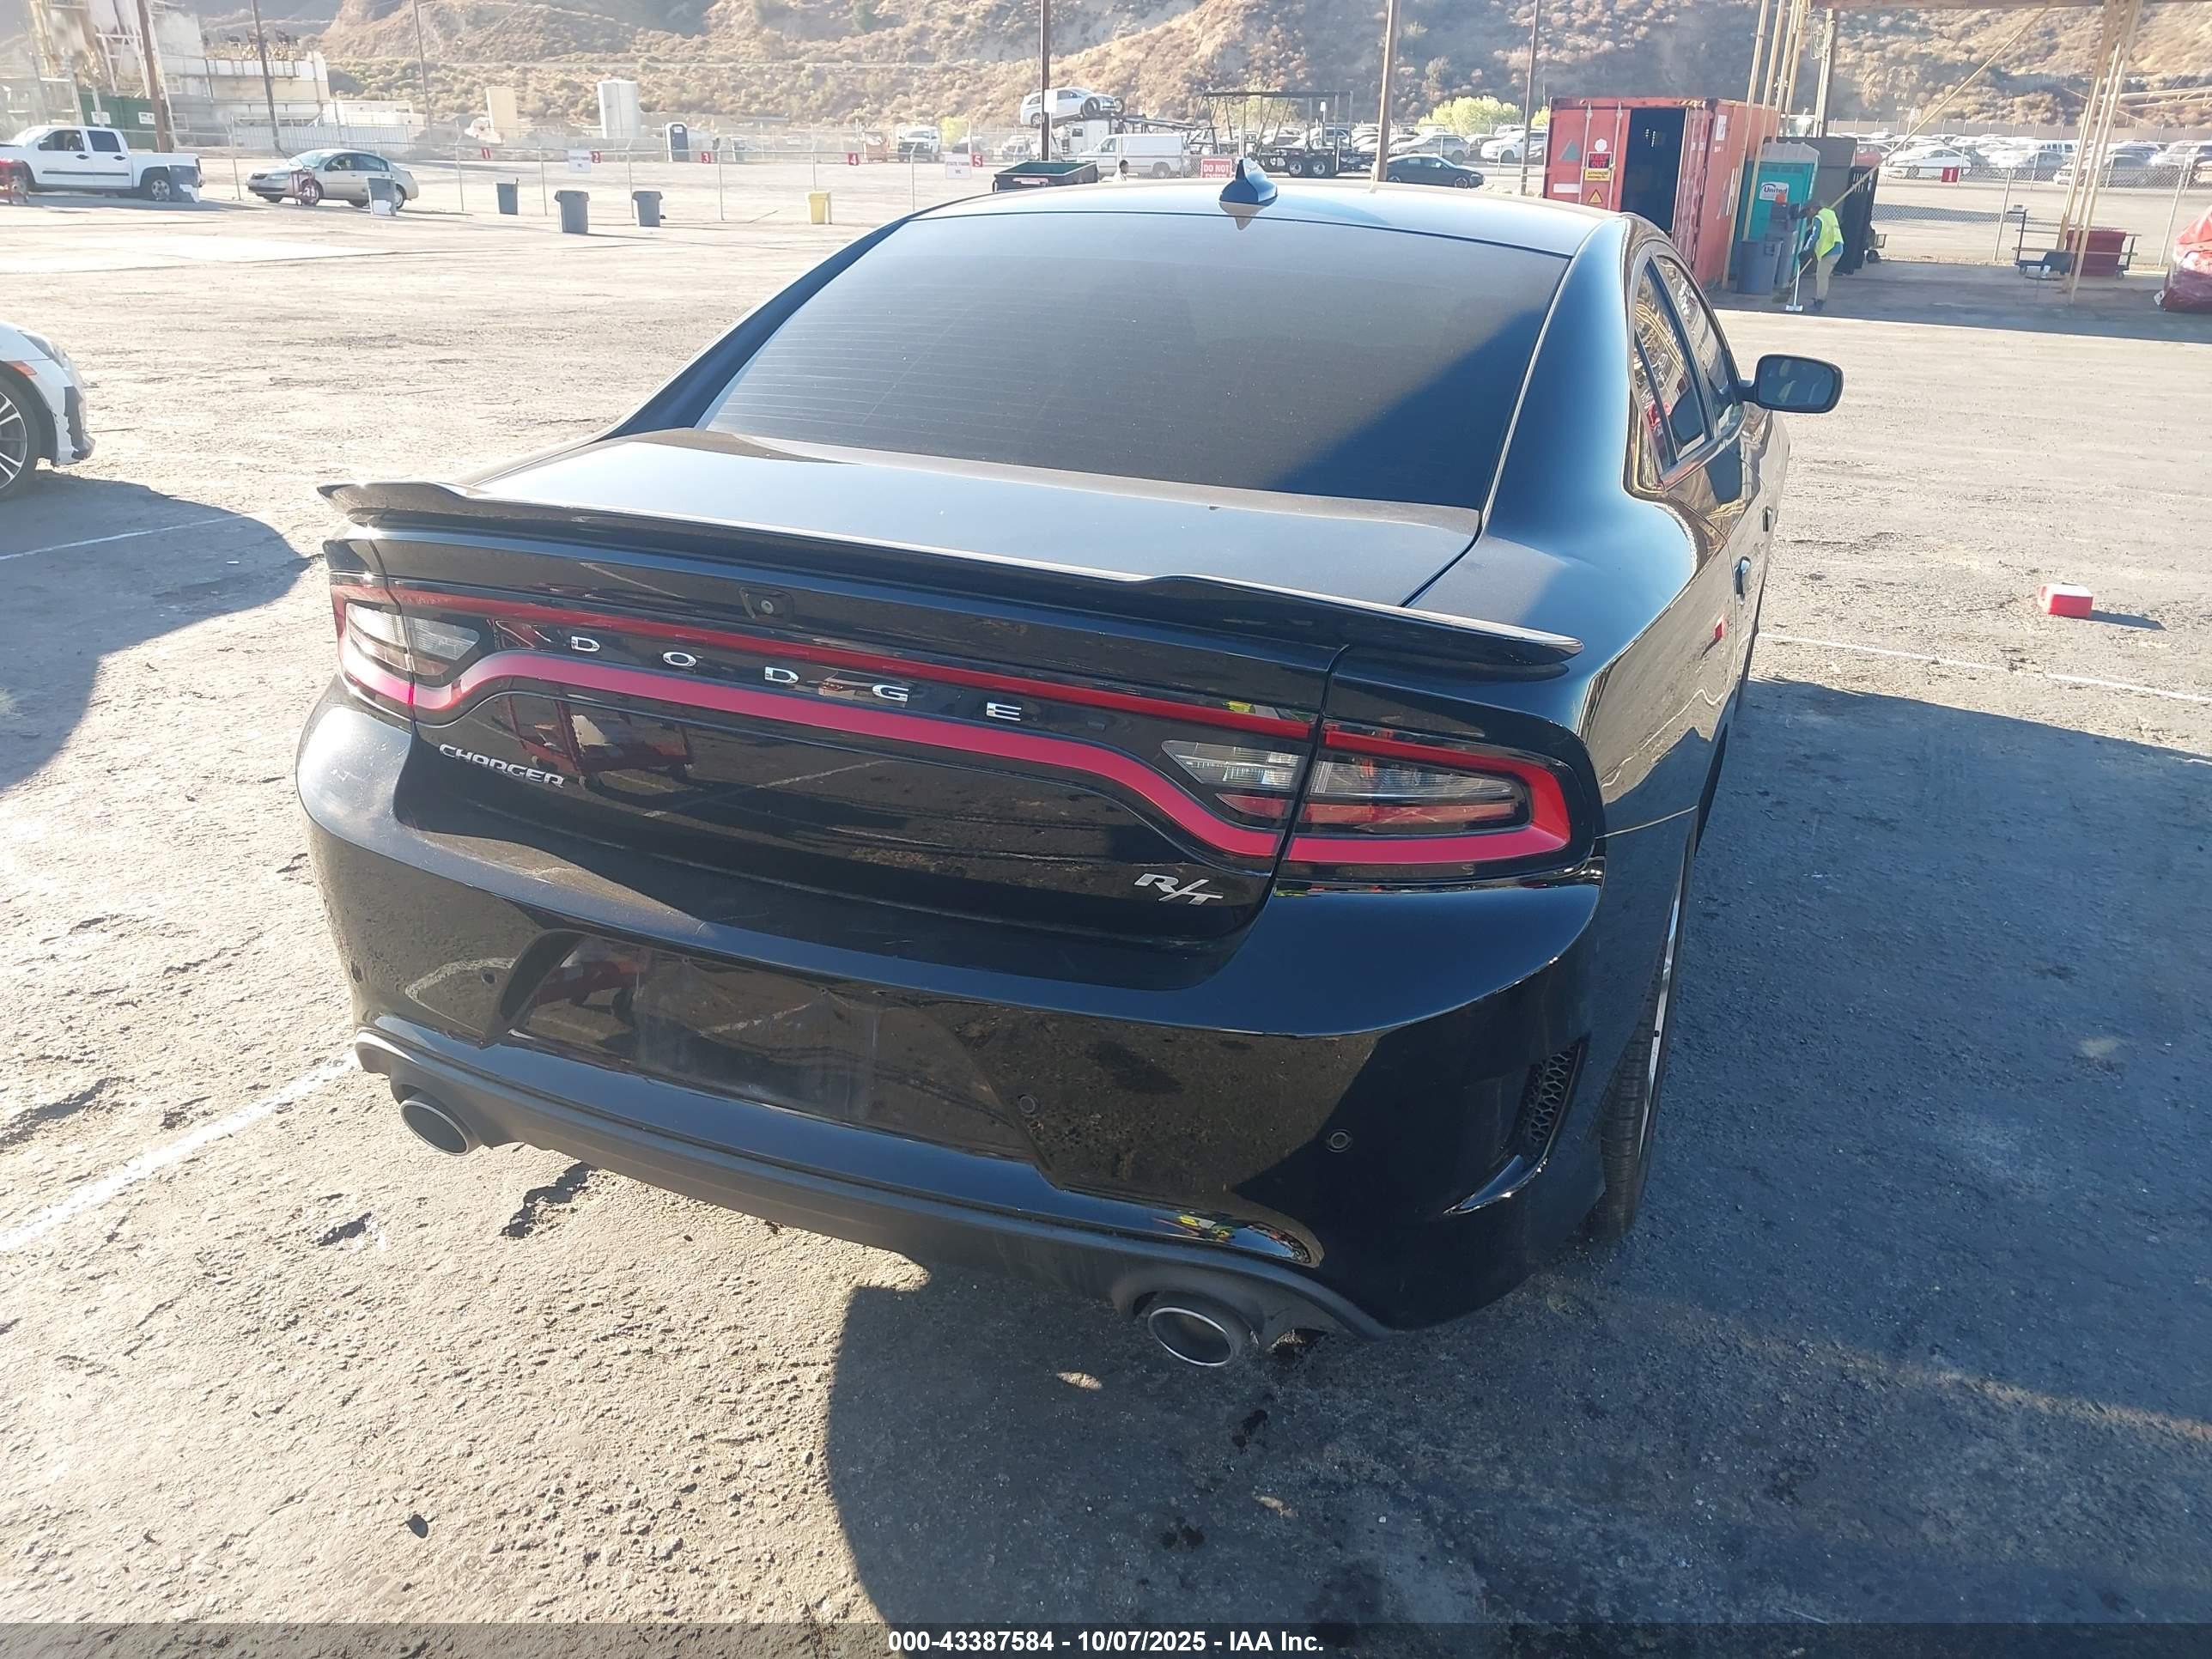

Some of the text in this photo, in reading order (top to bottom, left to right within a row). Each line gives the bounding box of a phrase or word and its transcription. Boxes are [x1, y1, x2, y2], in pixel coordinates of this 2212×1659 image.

[974, 155, 981, 167] 5
[1203, 164, 1230, 173] DO NOT
[1764, 185, 1788, 194] United
[570, 635, 1022, 721] DODGE
[439, 744, 564, 788] CHARGER
[1133, 872, 1224, 906] R/T
